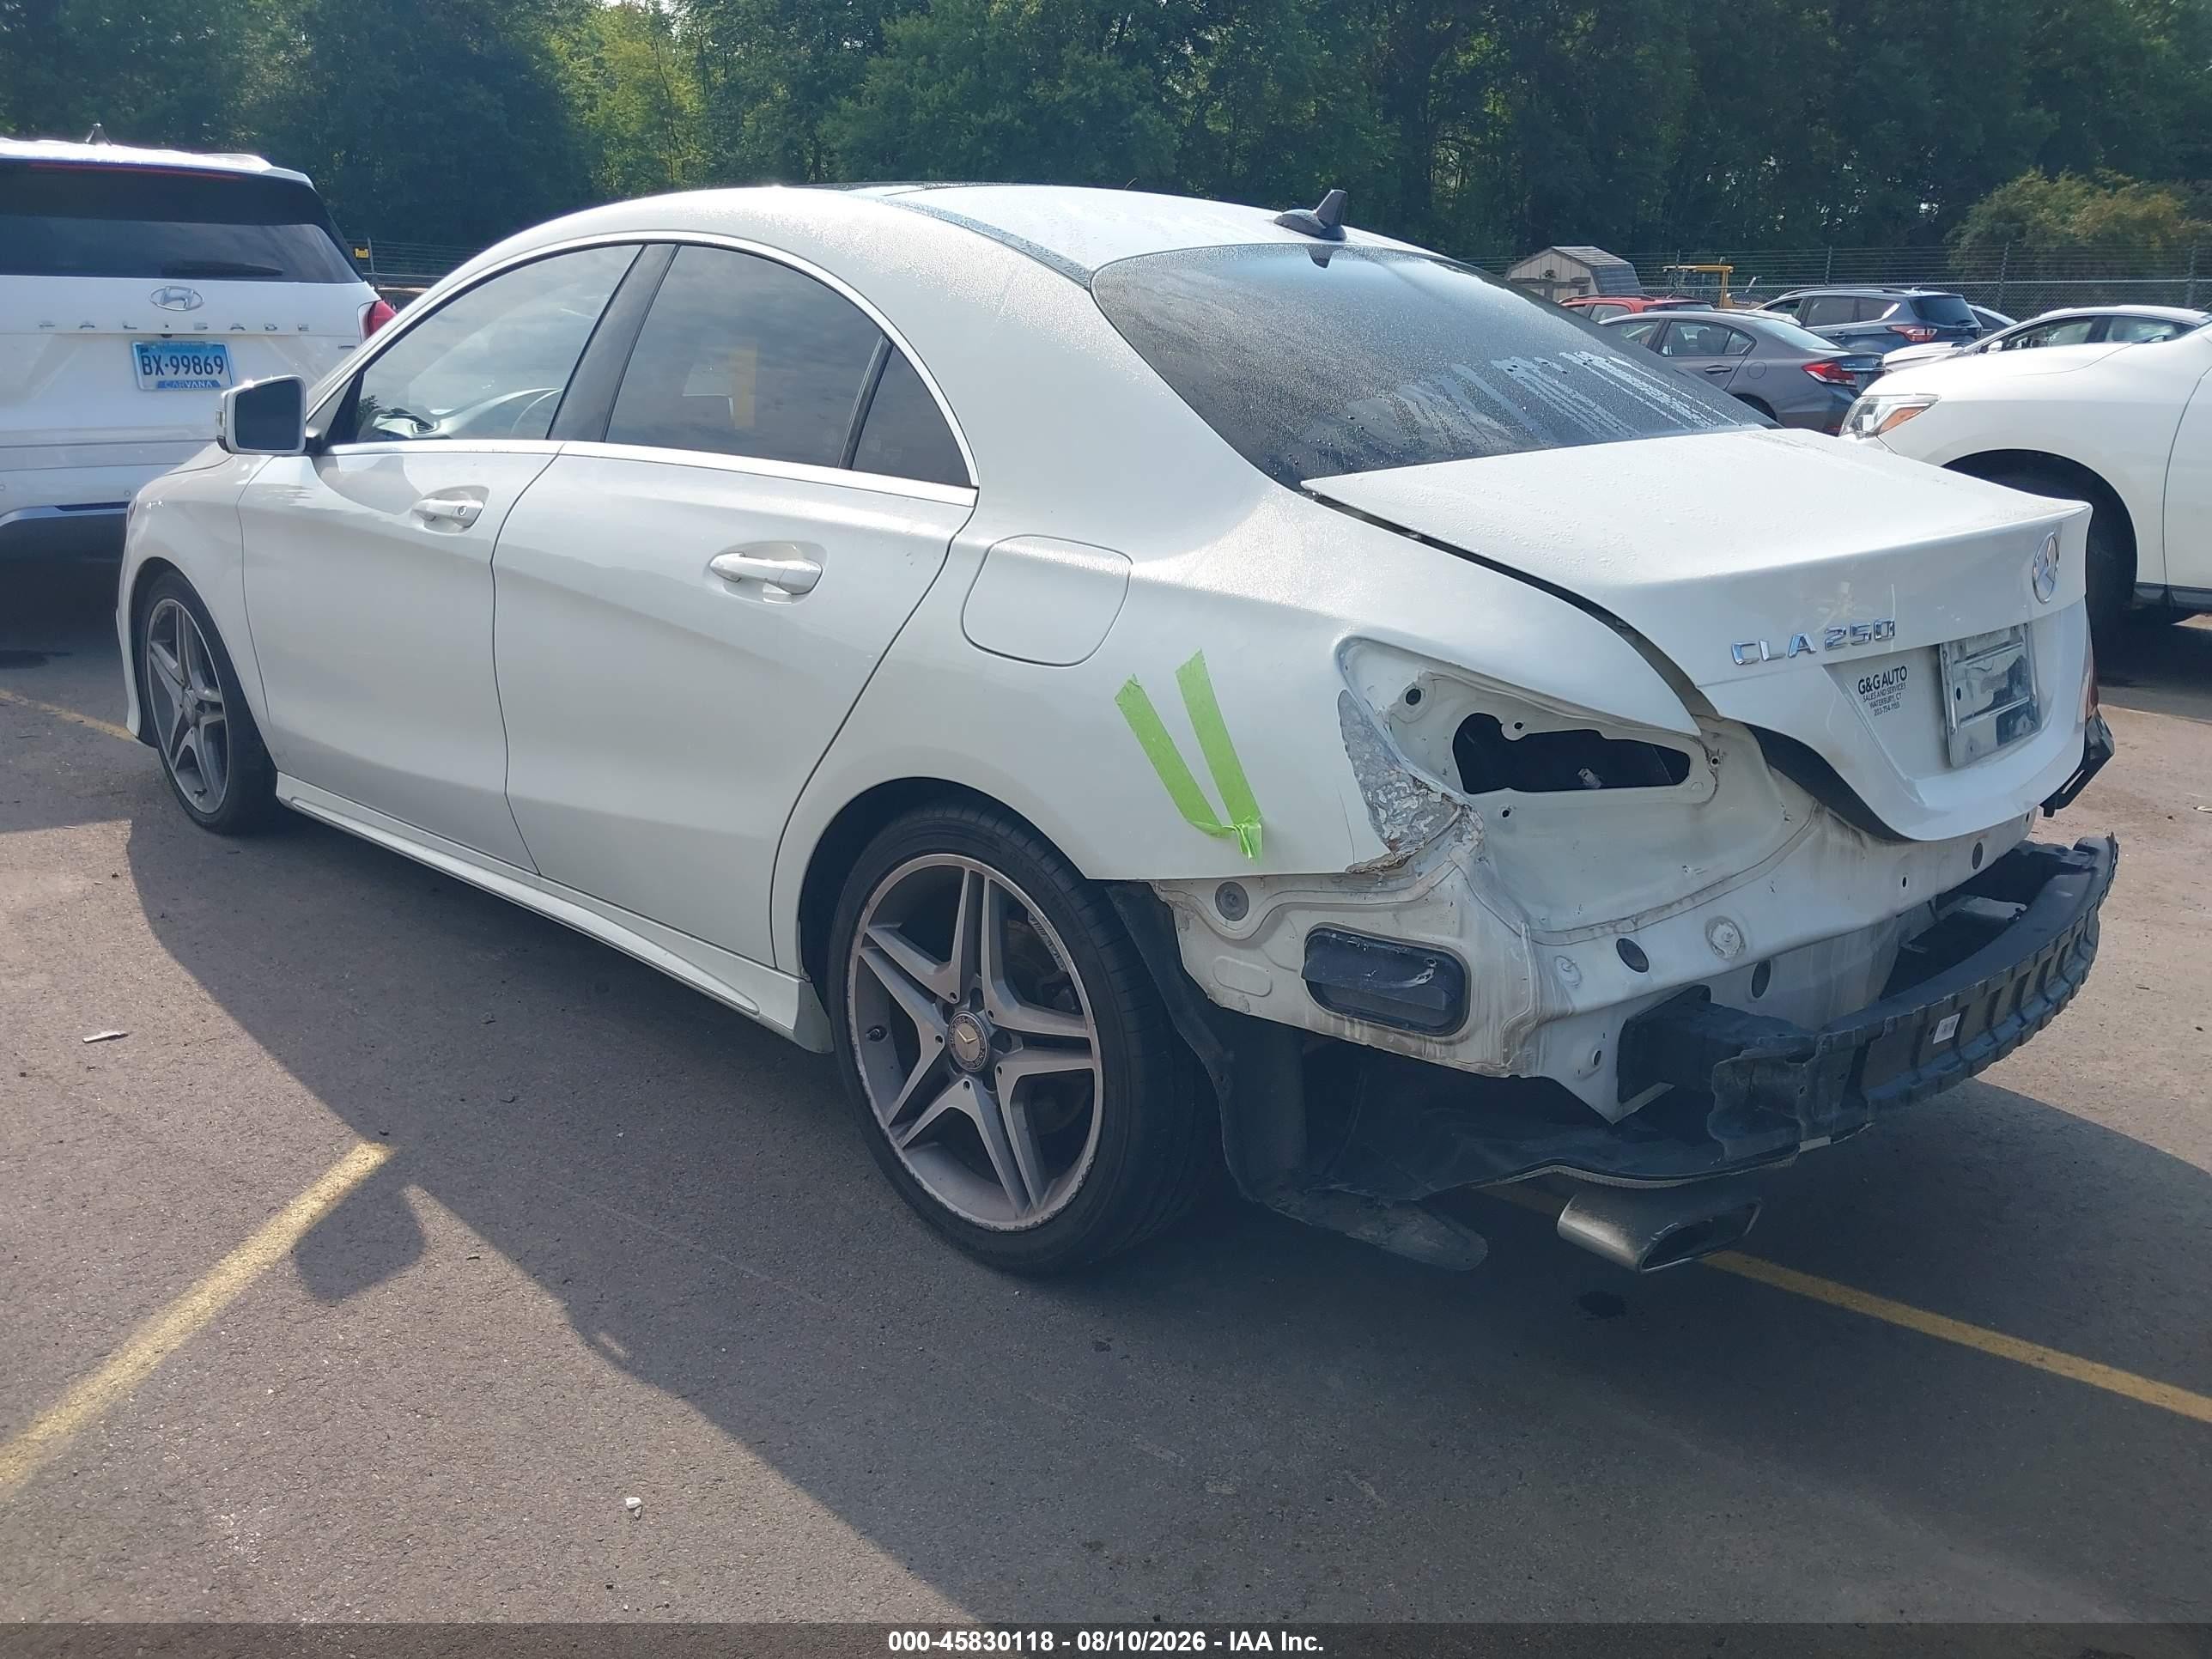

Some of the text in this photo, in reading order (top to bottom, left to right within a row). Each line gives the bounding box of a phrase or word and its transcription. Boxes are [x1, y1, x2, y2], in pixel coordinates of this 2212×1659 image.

[1731, 618, 1895, 665] CLA 250
[1858, 665, 1907, 695] G&G AUTO
[1863, 682, 1906, 702] SALES AND SERVICES
[1896, 692, 1902, 701] CT
